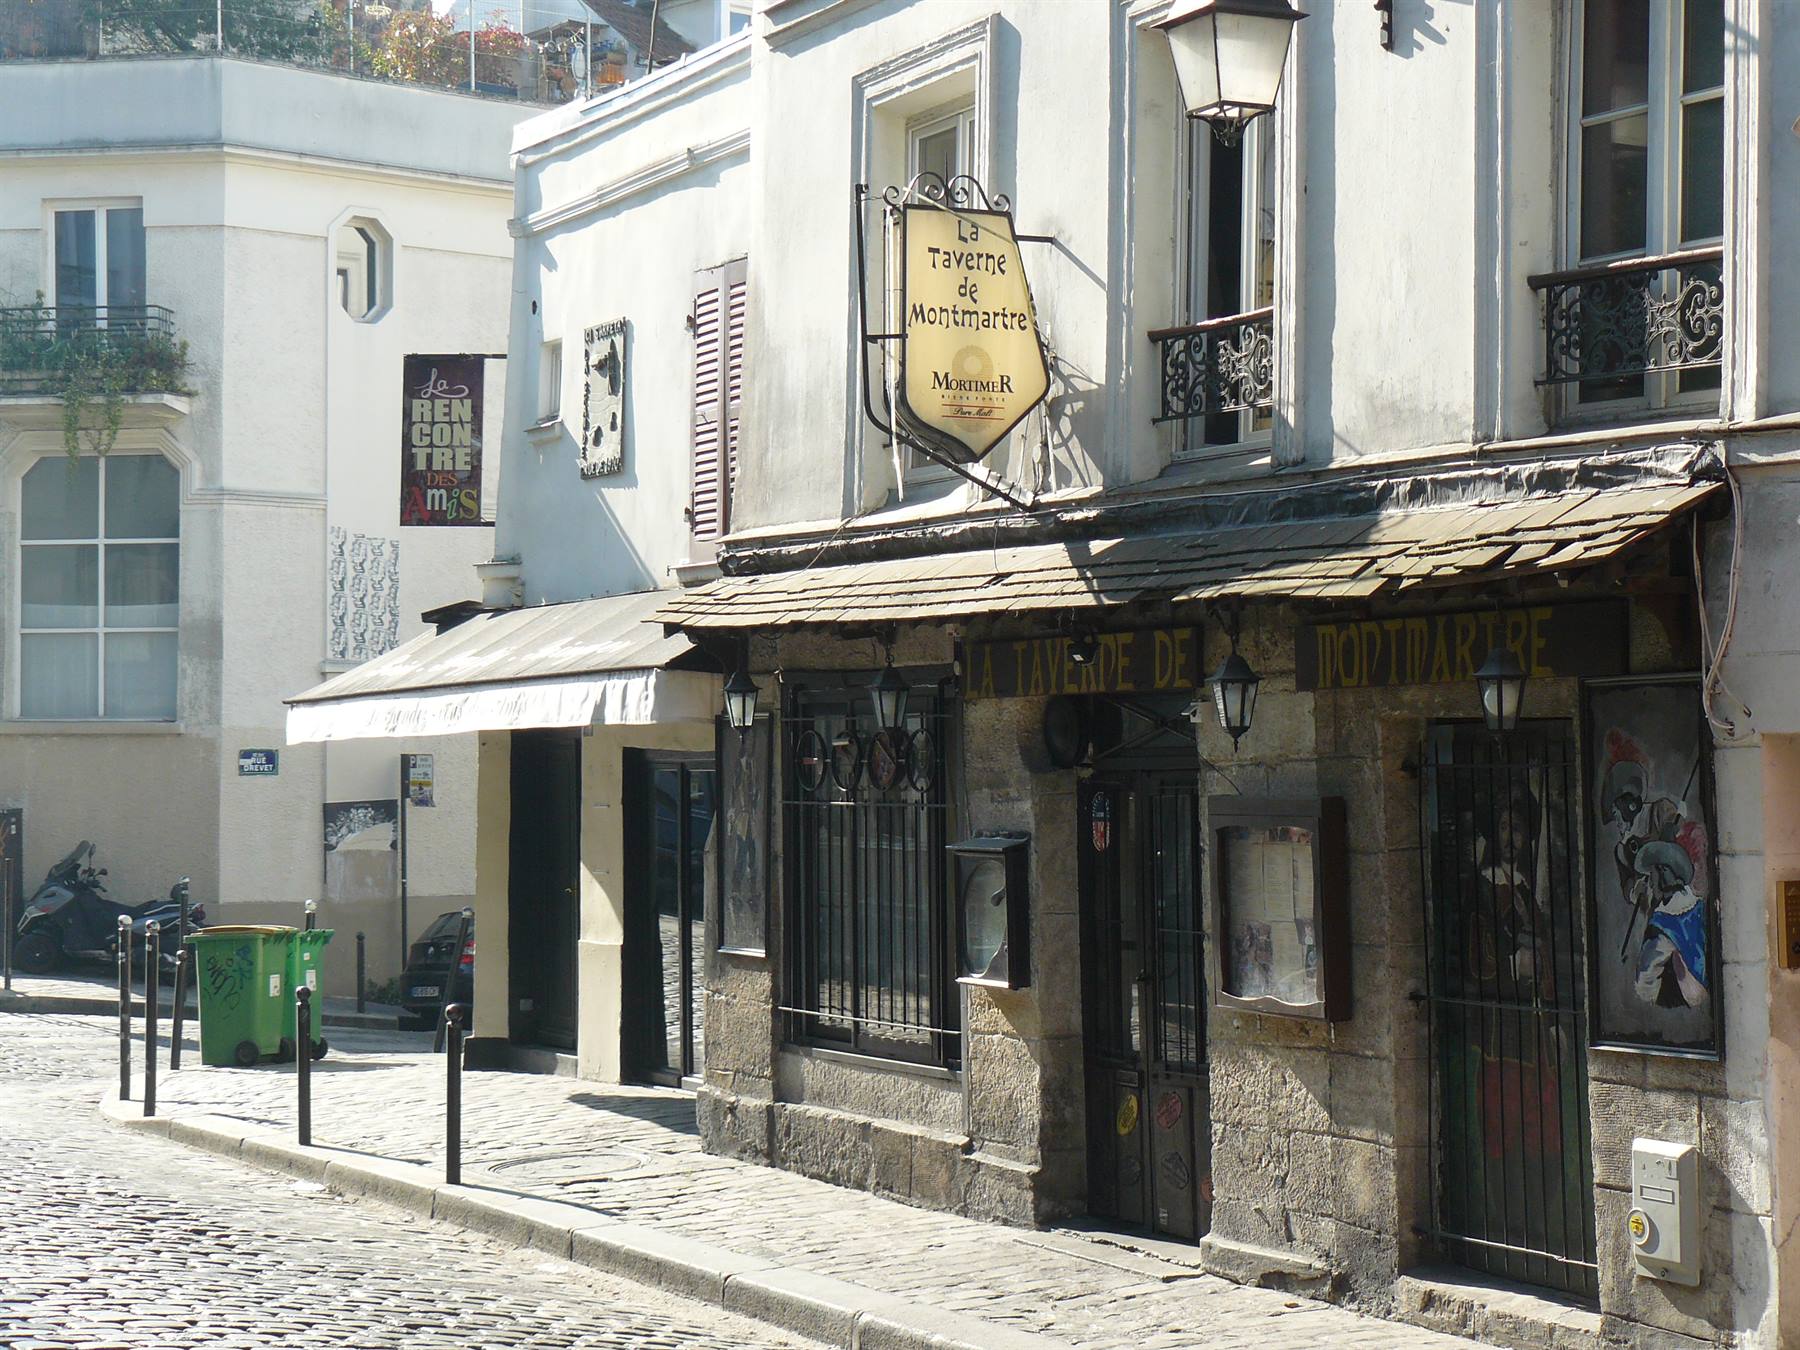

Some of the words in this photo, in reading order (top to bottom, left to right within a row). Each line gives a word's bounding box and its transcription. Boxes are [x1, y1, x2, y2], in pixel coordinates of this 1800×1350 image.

[957, 219, 980, 243] La
[927, 247, 1007, 275] Taverne
[957, 276, 978, 304] de
[907, 302, 1027, 331] Montmartre
[414, 367, 469, 398] La
[411, 399, 472, 422] REN
[411, 423, 472, 447] CON
[411, 447, 472, 471] TRE
[427, 472, 458, 486] DES
[964, 641, 995, 700] LA
[1154, 627, 1193, 689] DE
